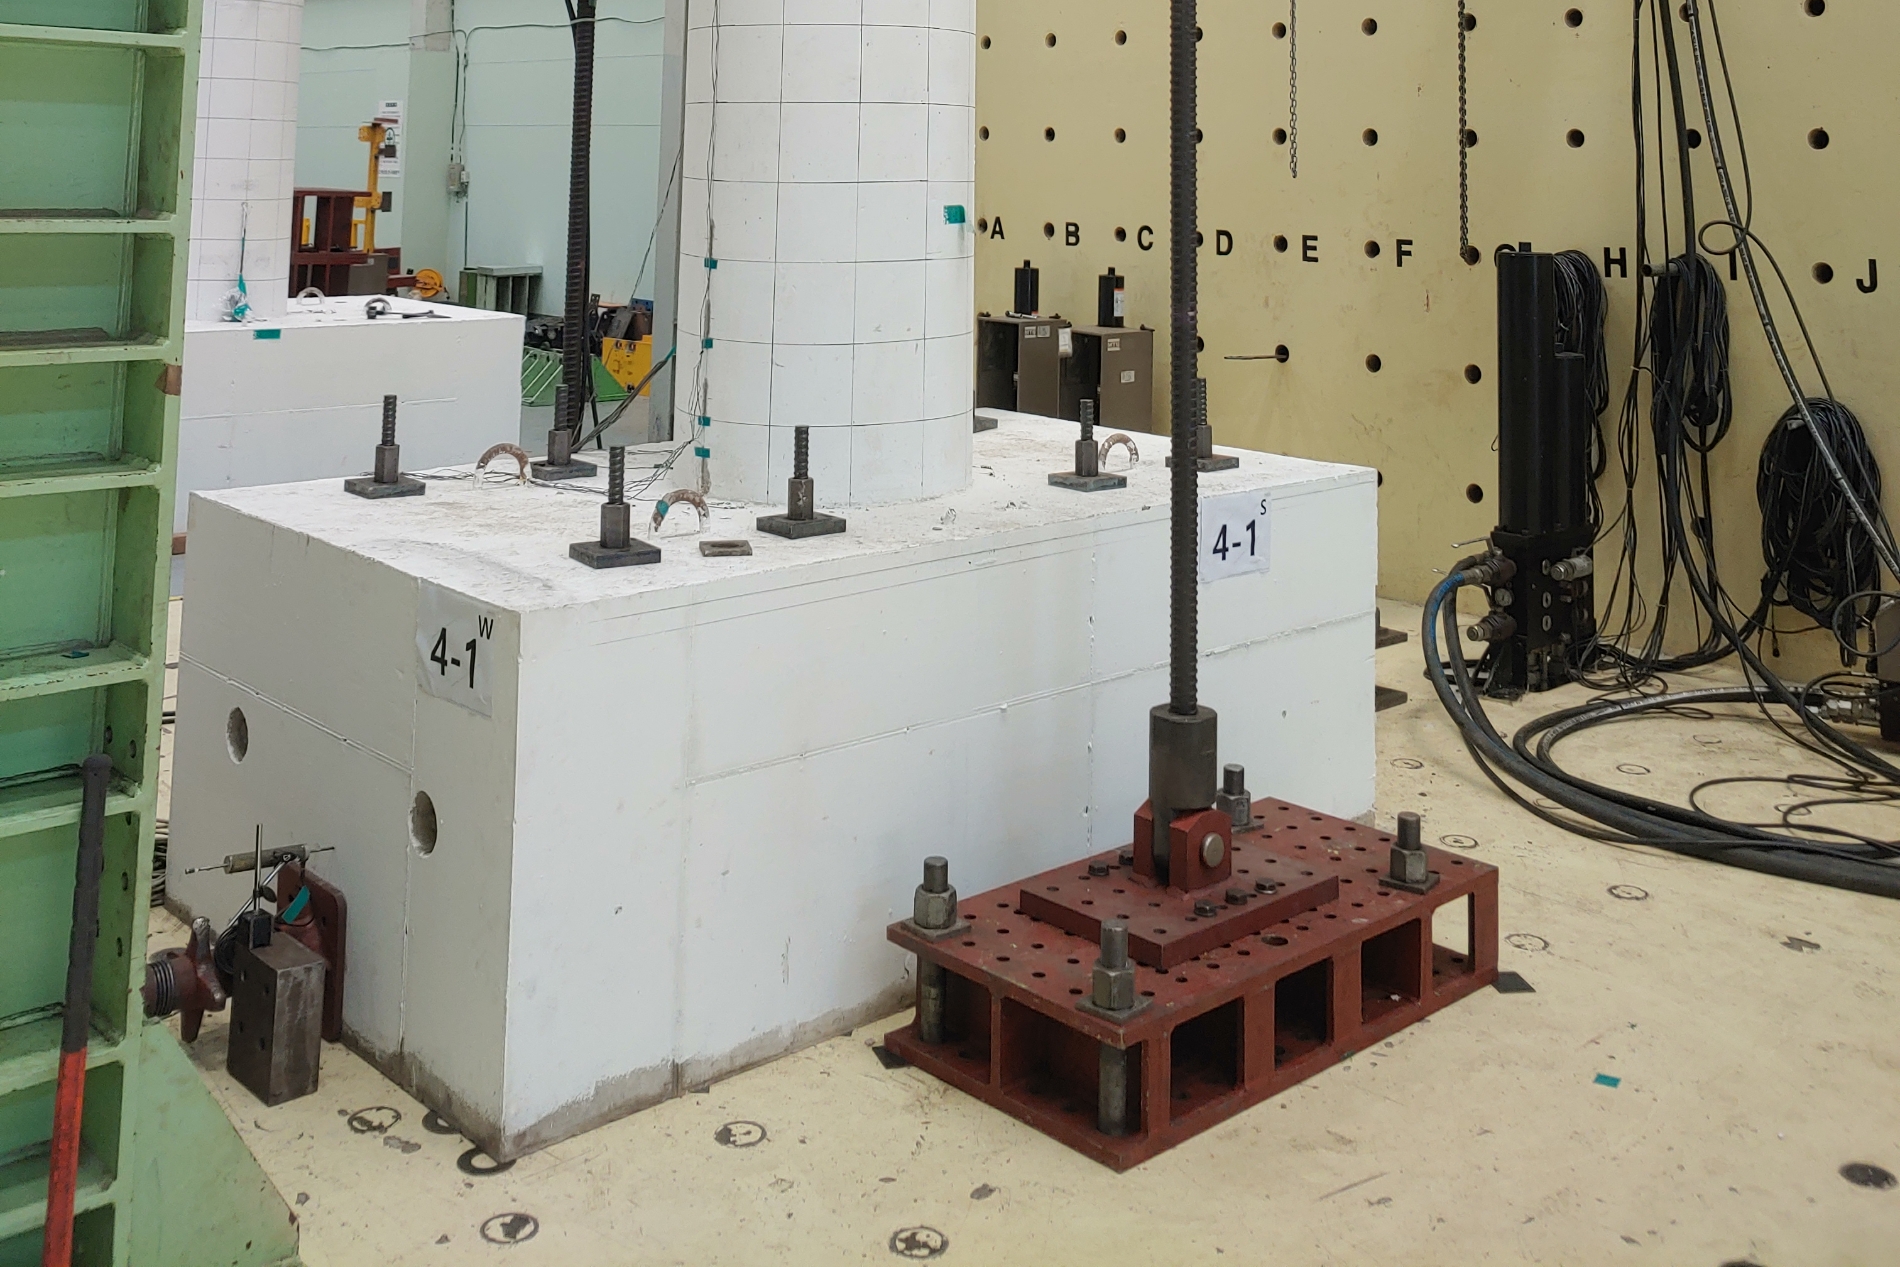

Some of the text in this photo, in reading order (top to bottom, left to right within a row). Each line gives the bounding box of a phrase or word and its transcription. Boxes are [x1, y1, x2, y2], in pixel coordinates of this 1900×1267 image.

[990, 216, 1005, 240] A
[1065, 222, 1080, 246] B
[1136, 225, 1154, 251] C
[1215, 229, 1233, 256] D
[1302, 234, 1319, 263] E
[1396, 238, 1413, 267] F
[1603, 246, 1628, 279] H
[1856, 258, 1878, 294] J
[1212, 498, 1267, 561] 4-1 S
[430, 614, 494, 689] 4-1 W
